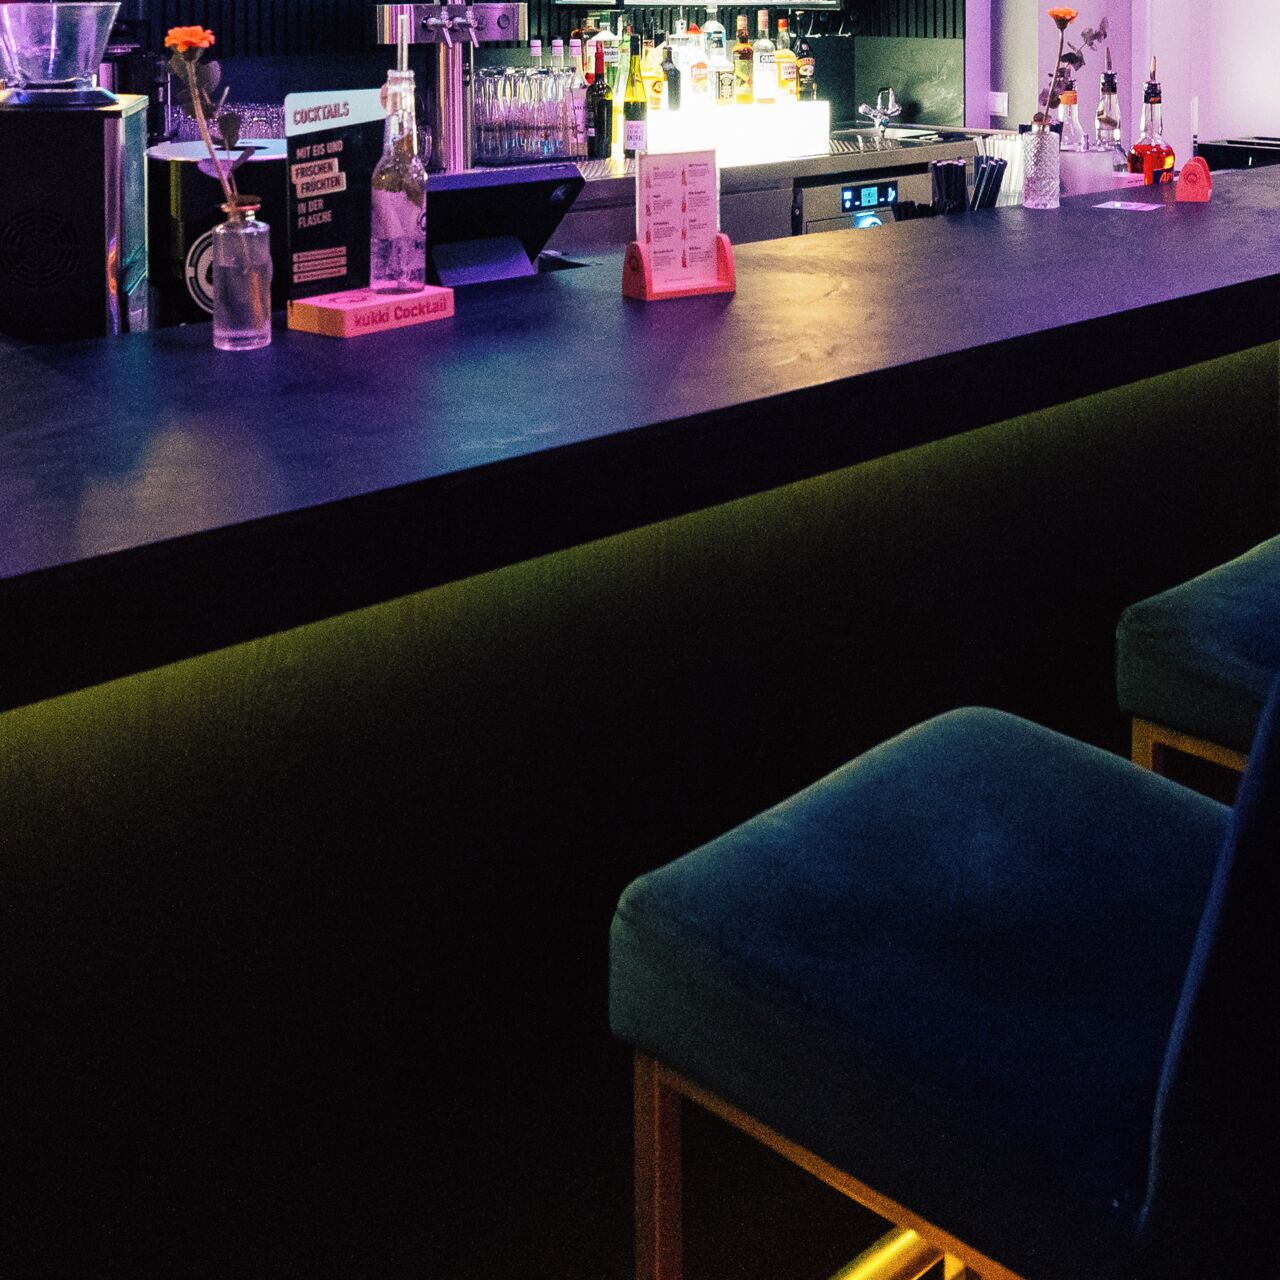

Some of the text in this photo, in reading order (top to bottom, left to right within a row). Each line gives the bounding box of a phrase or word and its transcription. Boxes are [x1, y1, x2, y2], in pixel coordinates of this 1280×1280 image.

[293, 101, 350, 125] COCKTAILS
[296, 146, 311, 160] MIT
[312, 143, 326, 157] EIS
[296, 161, 334, 180] FRISCHEN
[308, 198, 324, 212] DER
[298, 210, 333, 229] FLASCHE
[394, 298, 448, 321] Cocktail
